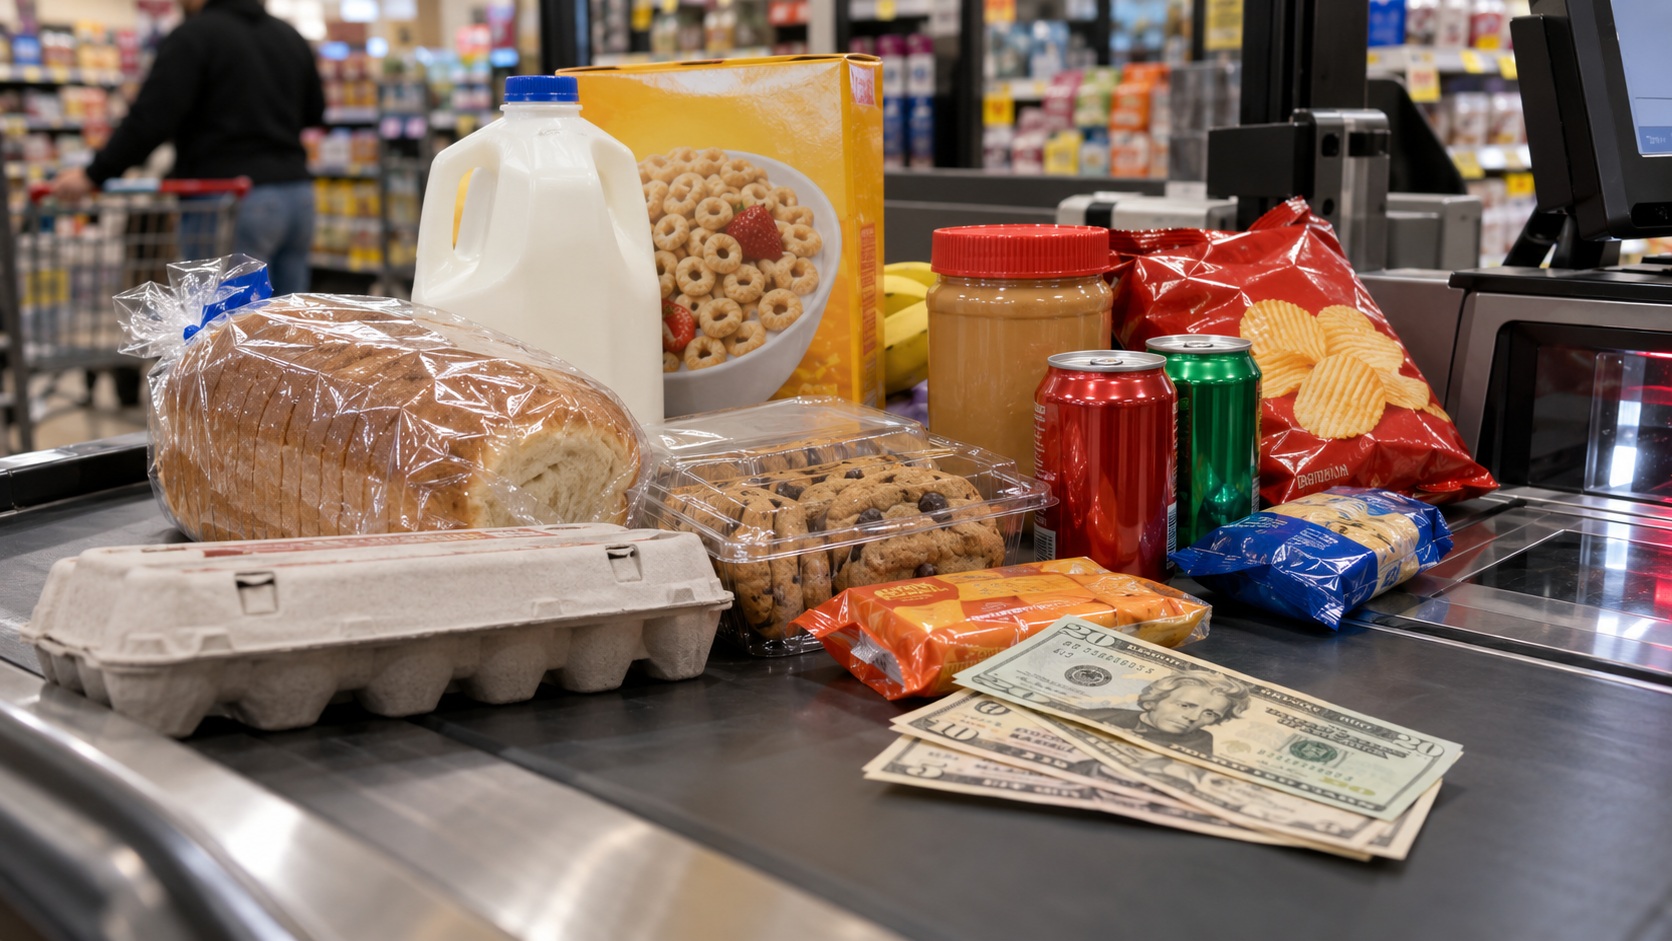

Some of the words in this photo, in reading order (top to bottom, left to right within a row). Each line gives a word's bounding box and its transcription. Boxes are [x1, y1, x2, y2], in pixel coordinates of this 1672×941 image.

[1062, 623, 1116, 647] 20
[1392, 733, 1445, 757] 20
[905, 763, 948, 780] 5
